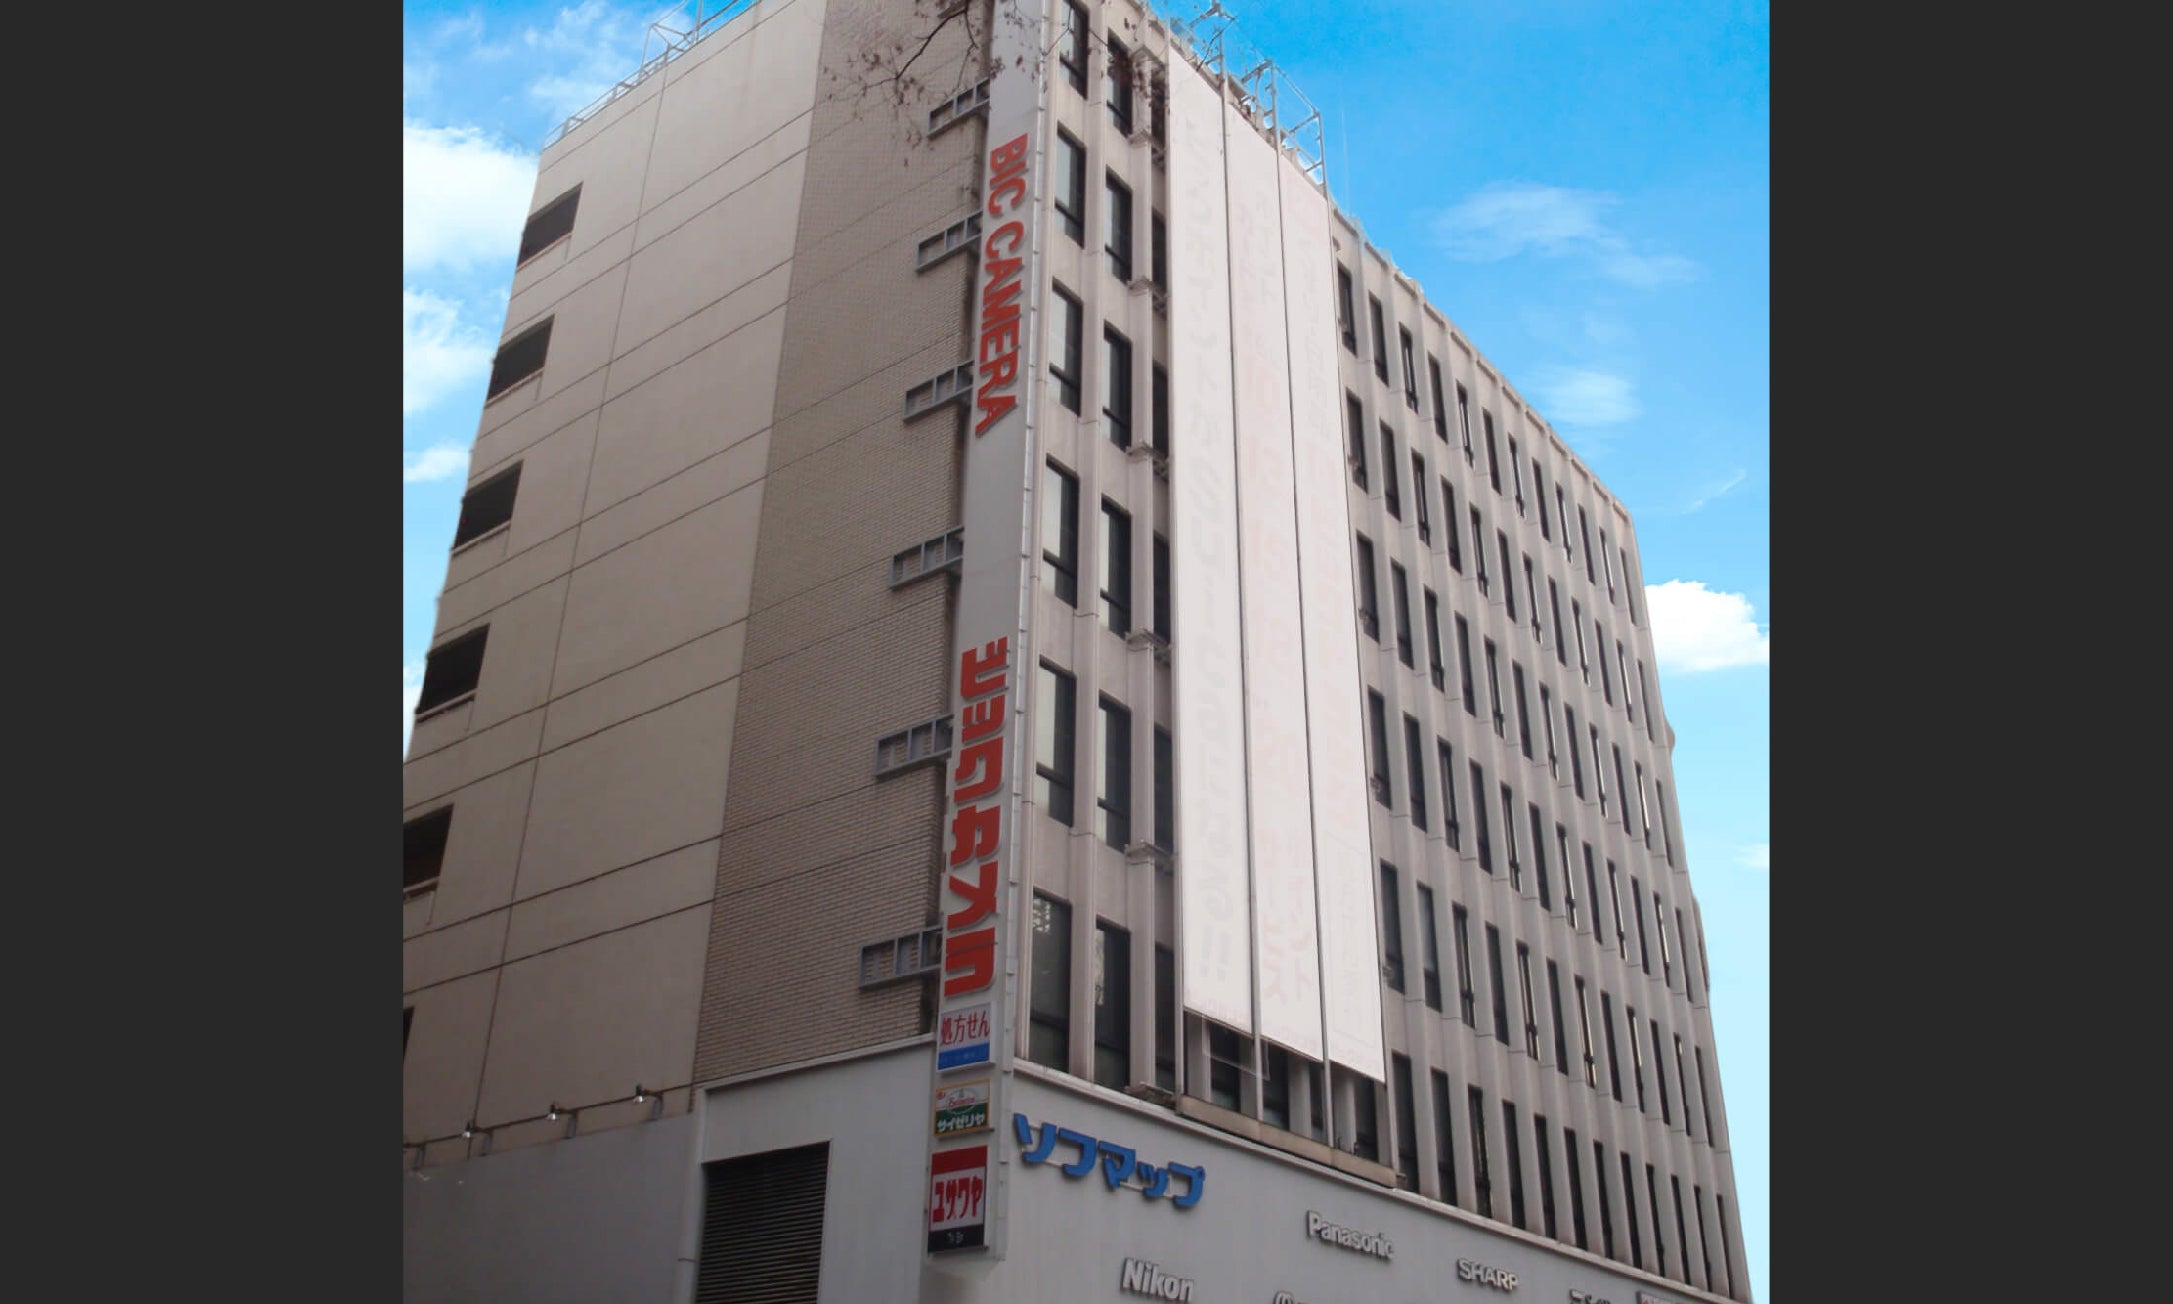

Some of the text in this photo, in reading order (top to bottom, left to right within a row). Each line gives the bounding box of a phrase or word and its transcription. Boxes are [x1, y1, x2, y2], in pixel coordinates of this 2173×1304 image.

[975, 133, 1029, 437] BIC CAMERA
[1014, 1113, 1206, 1207] ソフマップ
[1307, 1211, 1395, 1259] Panasonic
[1121, 1257, 1195, 1304] Nikon
[1457, 1259, 1520, 1292] SHARP
